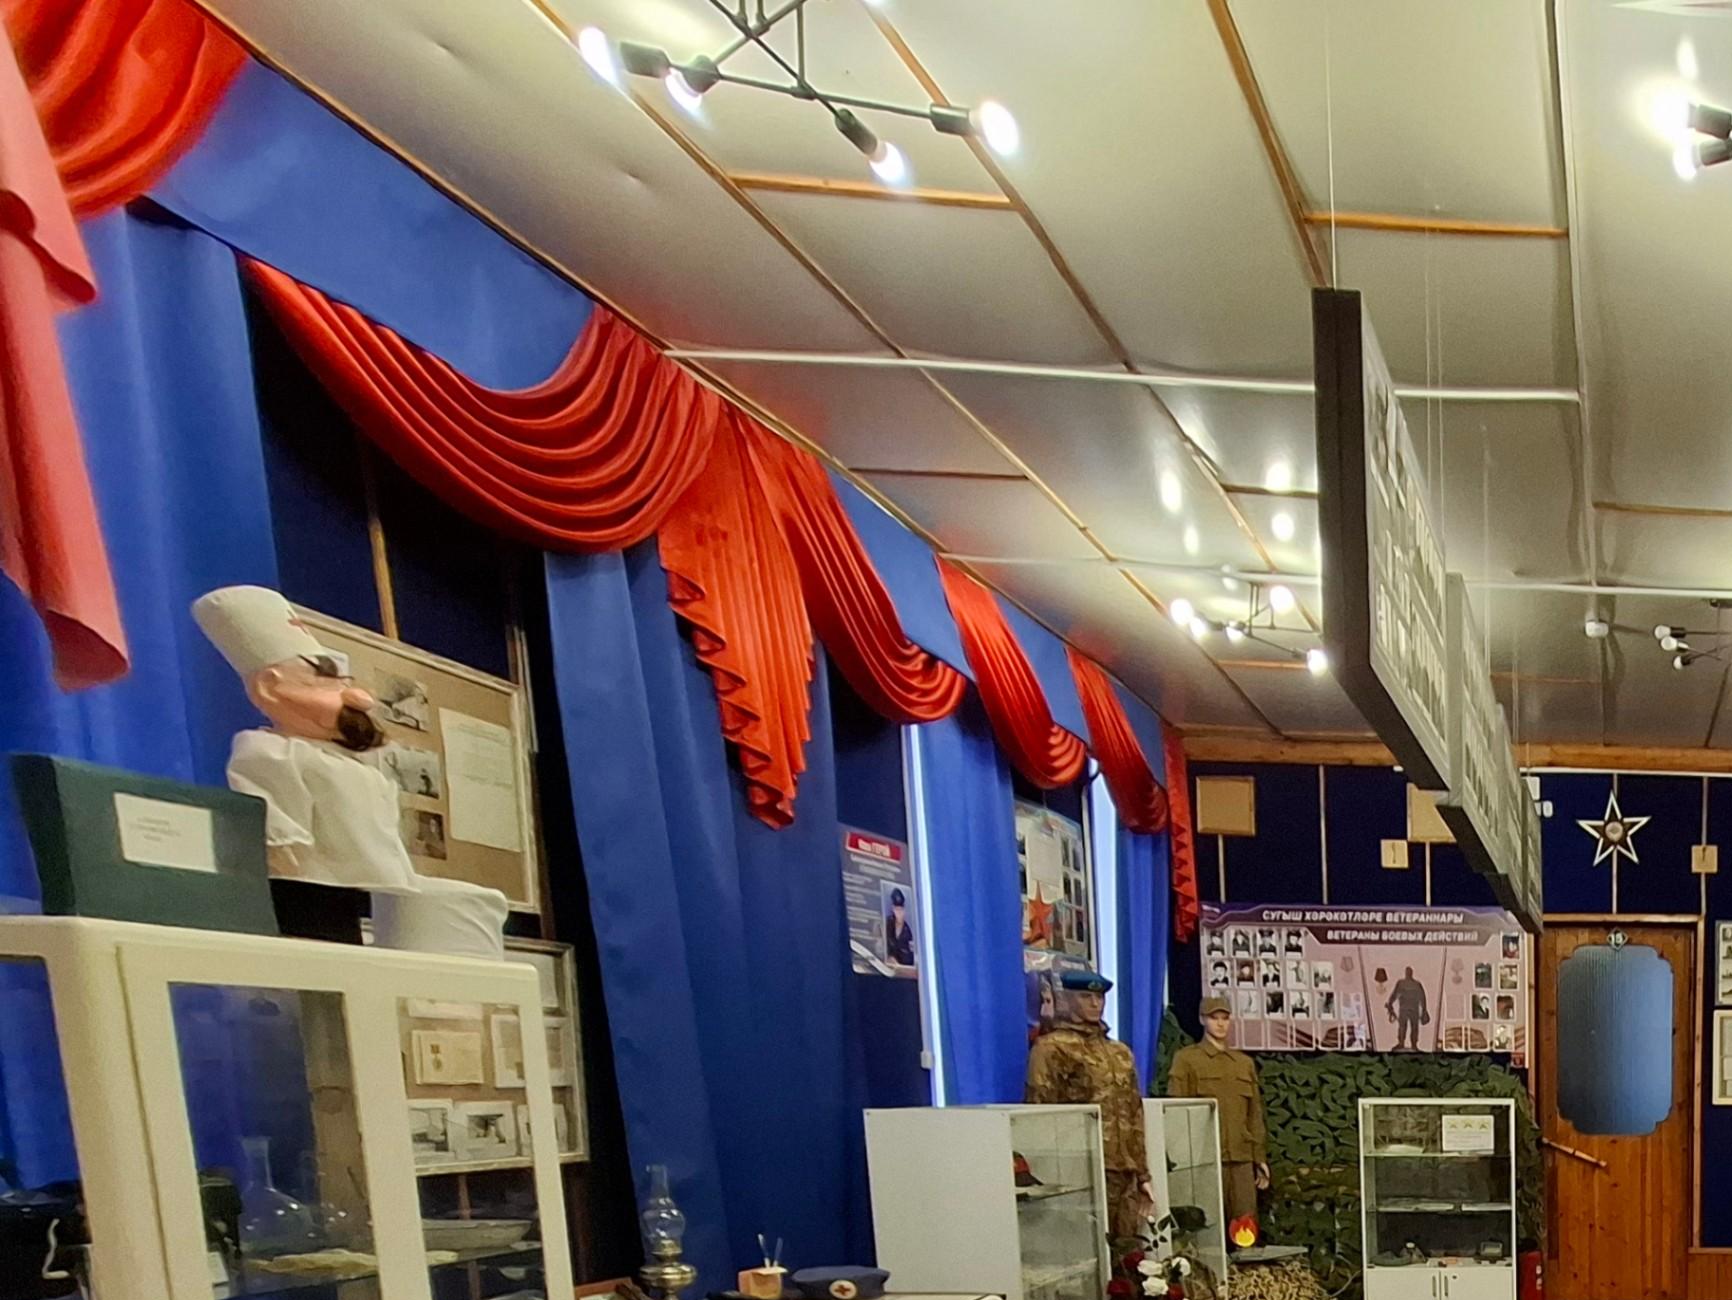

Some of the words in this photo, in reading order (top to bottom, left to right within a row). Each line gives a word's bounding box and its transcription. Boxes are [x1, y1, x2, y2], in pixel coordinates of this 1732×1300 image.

[1262, 910, 1302, 921] СУГЫШ
[1385, 911, 1464, 923] ВЕТЕРАННАРЫ
[1327, 930, 1380, 941] ВЕТЕРАНЫ
[1381, 930, 1423, 941] БОЕВЫХ
[1424, 930, 1479, 942] ДЕЙСТВИЙ
